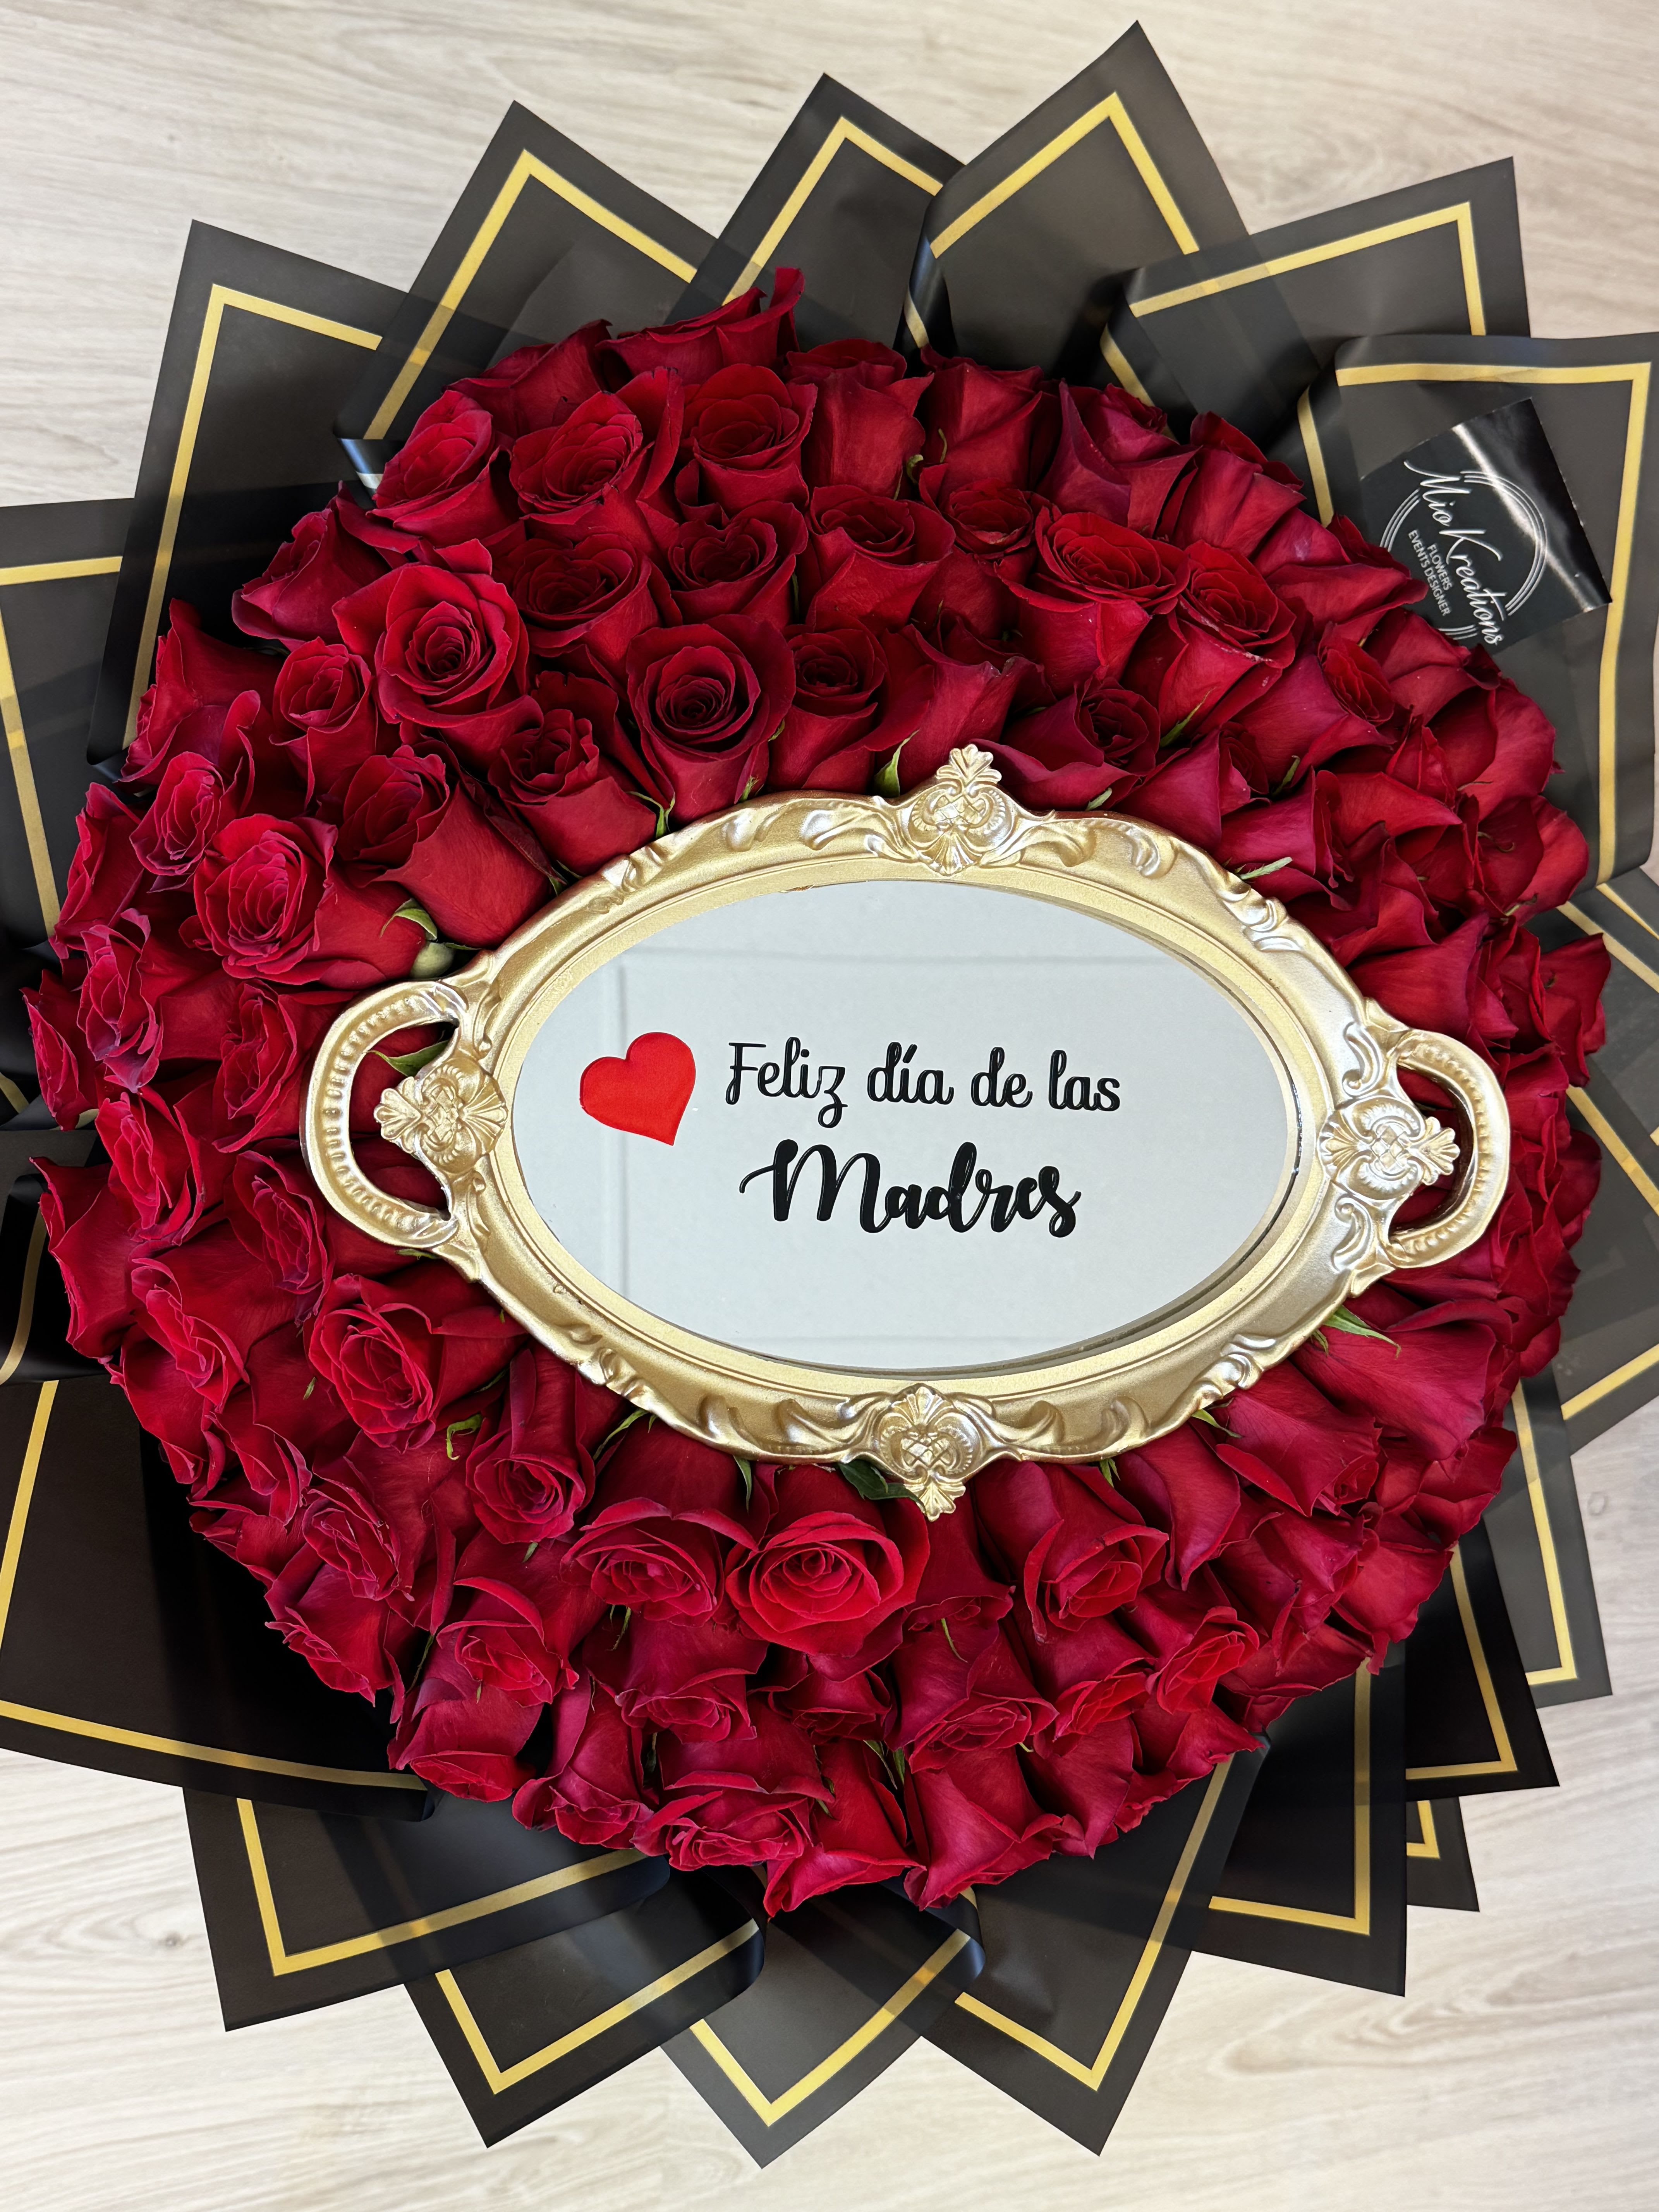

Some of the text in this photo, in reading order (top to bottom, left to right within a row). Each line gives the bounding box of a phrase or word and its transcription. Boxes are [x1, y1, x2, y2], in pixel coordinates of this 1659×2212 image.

[1403, 459, 1508, 646] Mio Kreations
[1408, 529, 1451, 617] EVENTS DESIGNER
[1427, 543, 1452, 591] FLOWERS
[725, 1037, 1120, 1128] Feliz día de las
[739, 1139, 1082, 1238] Madres
